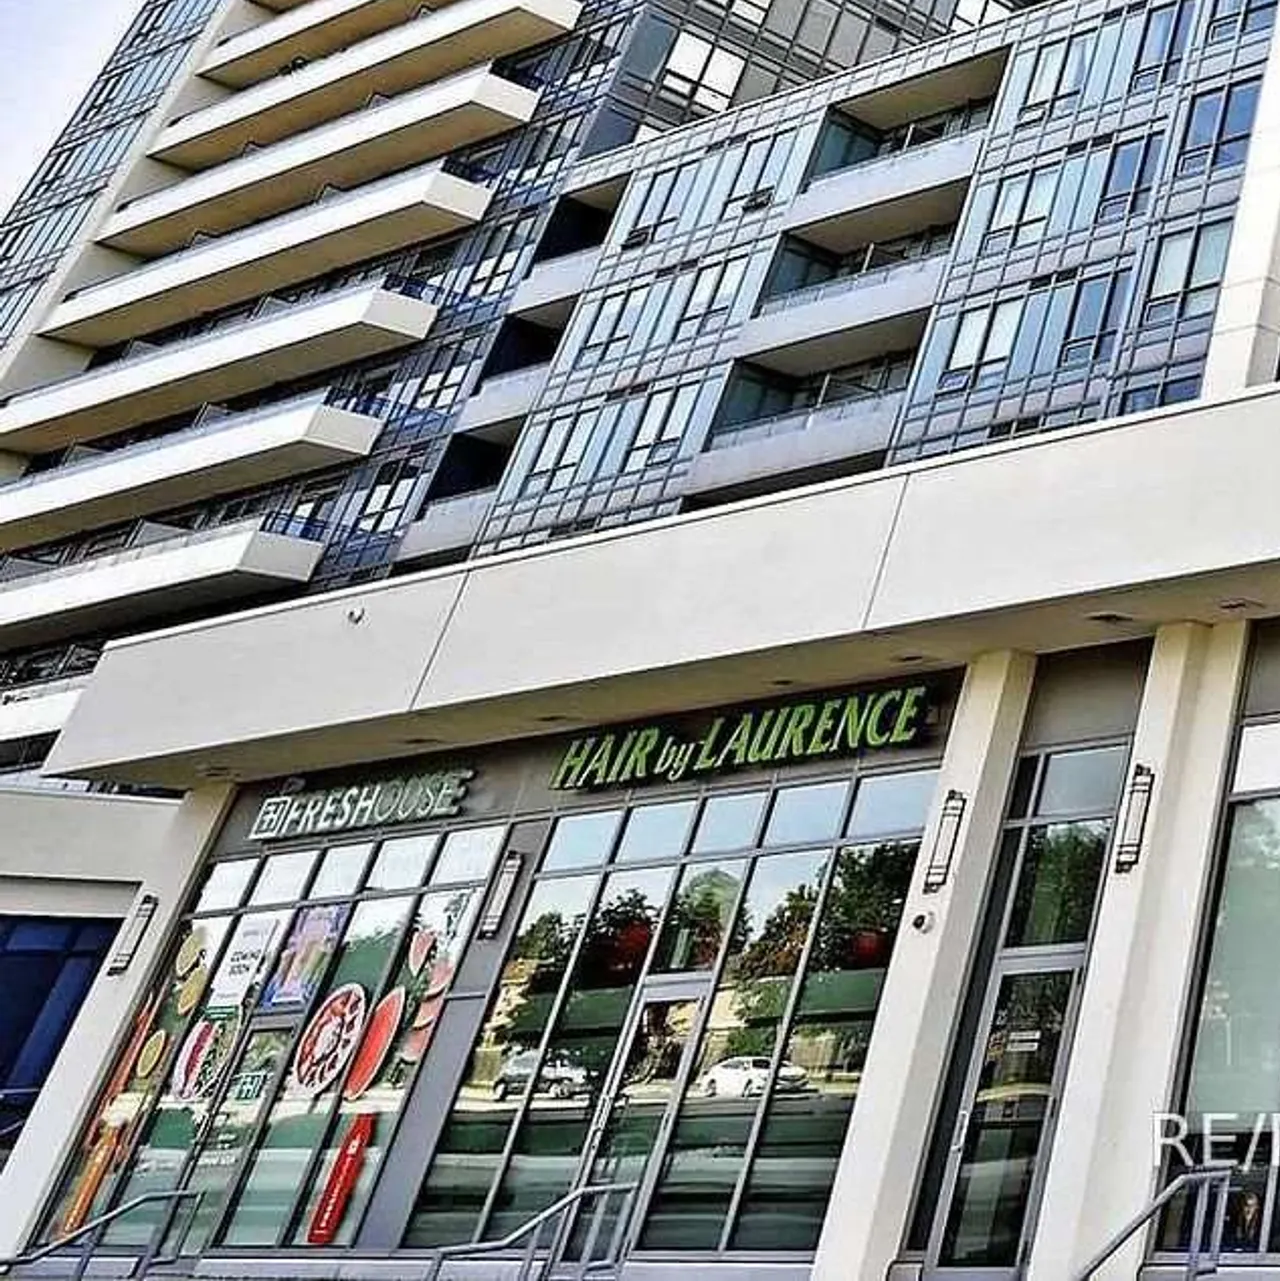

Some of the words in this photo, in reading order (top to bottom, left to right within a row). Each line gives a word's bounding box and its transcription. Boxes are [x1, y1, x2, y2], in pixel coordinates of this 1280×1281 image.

[551, 727, 660, 791] HAIR
[653, 735, 696, 781] by
[694, 686, 926, 771] LAURENCE
